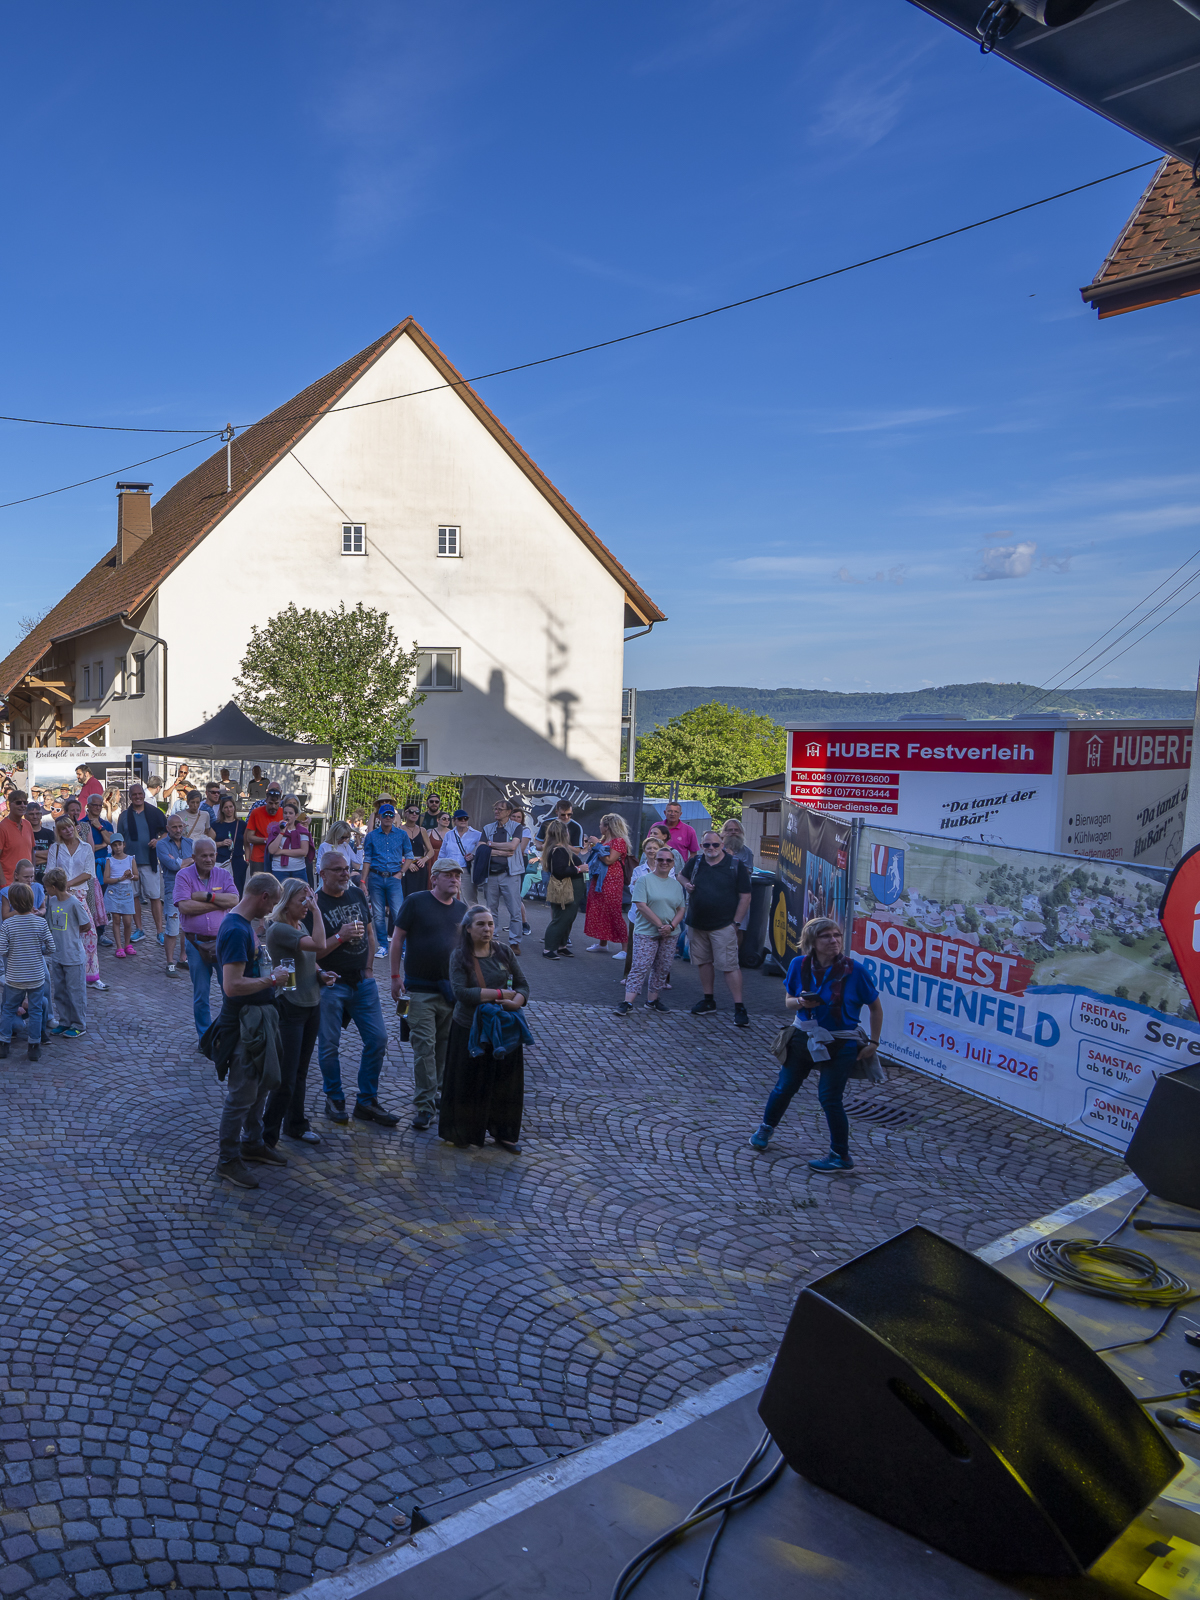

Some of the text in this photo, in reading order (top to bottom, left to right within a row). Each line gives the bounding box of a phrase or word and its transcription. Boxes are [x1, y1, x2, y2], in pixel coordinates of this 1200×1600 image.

[35, 750, 69, 759] Breitenfeld
[826, 742, 1035, 760] HUBER Festverleih
[1112, 735, 1180, 766] HUBER
[795, 772, 890, 784] Tel. 0049 (0)7761/3600
[795, 786, 890, 798] Fax 0049 (0)7761/3444
[971, 792, 1009, 809] tanzt
[1010, 790, 1037, 803] der
[1156, 788, 1180, 815] tanzt
[800, 801, 893, 813] ww.huber-dienste.de
[1075, 813, 1112, 828] Bierwagen
[1073, 831, 1112, 845] Kühlwagen
[864, 920, 1018, 991] DORFFEST
[861, 957, 1061, 1048] BREITENFELD
[1080, 1001, 1128, 1022] FREITAG
[1079, 1013, 1131, 1035] 19:00 Uhr
[879, 1036, 948, 1071] breitenfeld-wt.de
[962, 1042, 992, 1065] Juli
[996, 1053, 1039, 1082] 2026
[1087, 1050, 1142, 1075] SAMSTAG
[1086, 1063, 1133, 1084] ab 16 Uhr
[1093, 1098, 1140, 1123] SONNTA
[1089, 1111, 1136, 1133] ab 12 Uh
